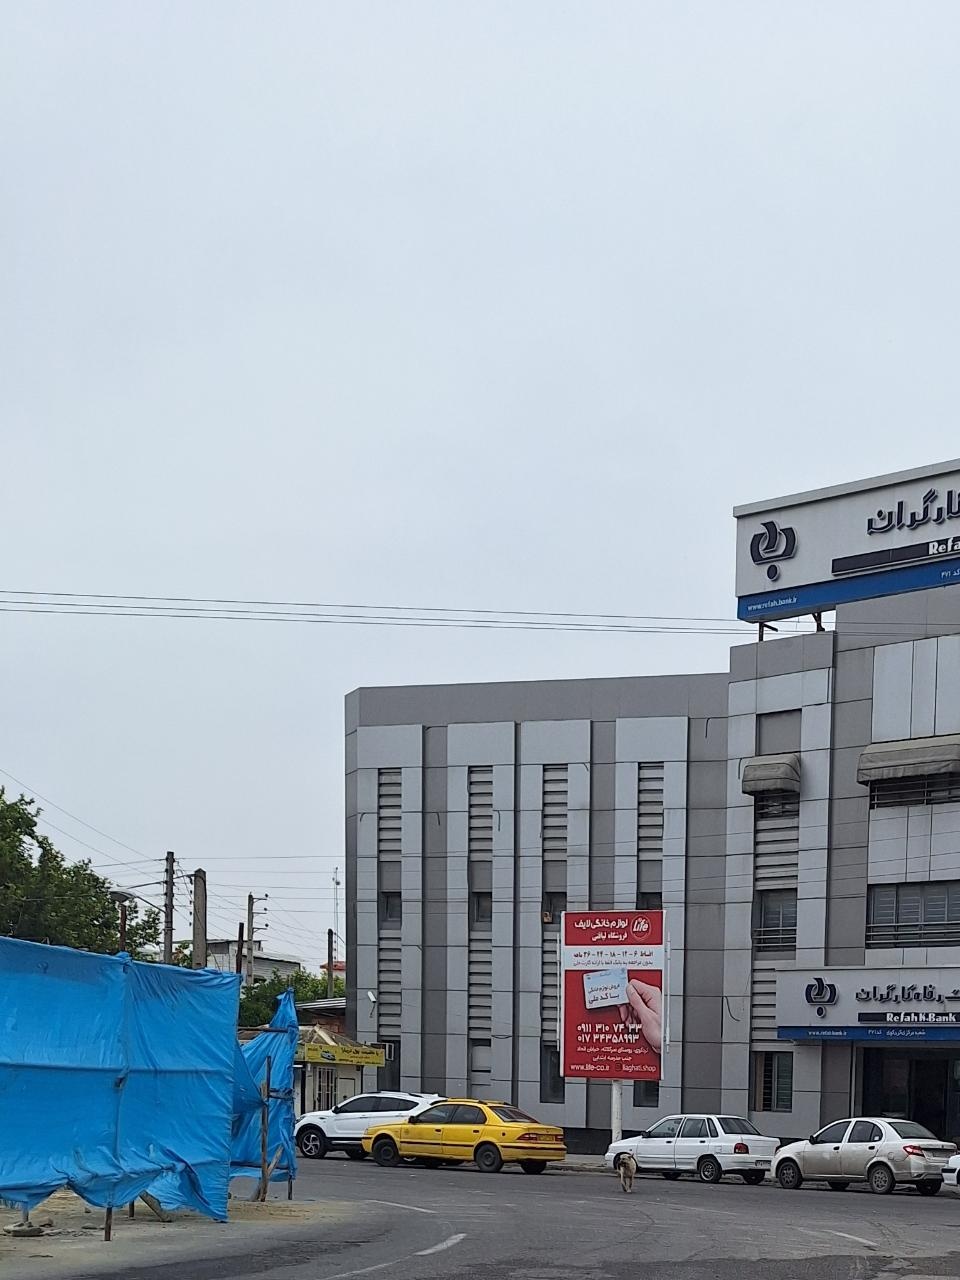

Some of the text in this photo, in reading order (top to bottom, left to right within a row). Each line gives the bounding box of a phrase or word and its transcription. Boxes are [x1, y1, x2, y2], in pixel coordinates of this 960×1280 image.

[574, 918, 628, 930] لوازم خانگی لایف
[633, 917, 649, 932] Life
[608, 931, 628, 941] فروشگاه
[855, 984, 916, 1004] کارگران
[914, 984, 945, 1004] رفاه
[886, 1012, 957, 1023] Refah K.Bank
[577, 1023, 642, 1033] ۰۹۱۱ ۳۱۰ ۷۴ ۳۳
[577, 1033, 640, 1043] ۰۱۷ ۳۴۳۵۸۹۹۳
